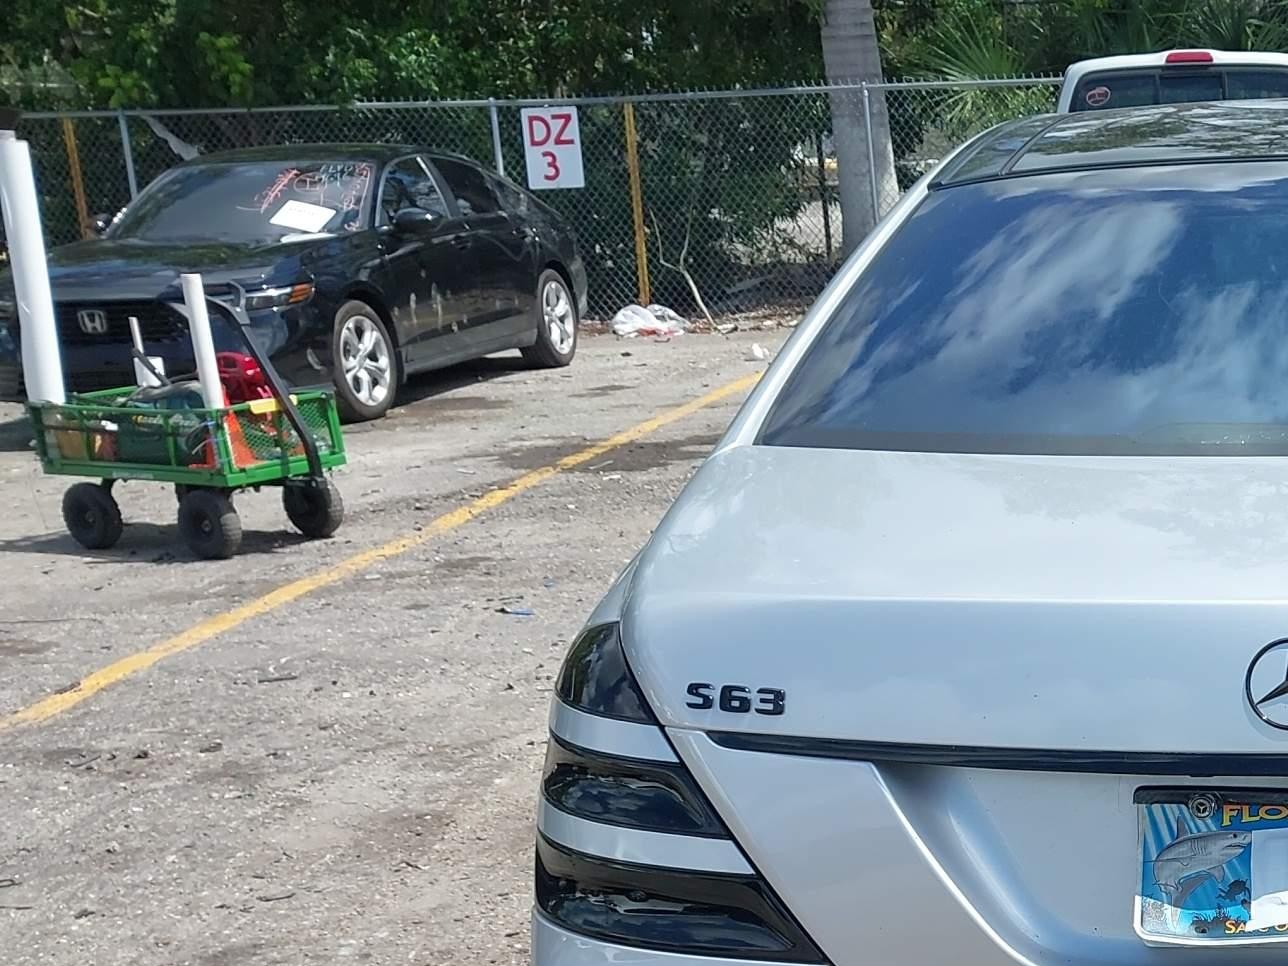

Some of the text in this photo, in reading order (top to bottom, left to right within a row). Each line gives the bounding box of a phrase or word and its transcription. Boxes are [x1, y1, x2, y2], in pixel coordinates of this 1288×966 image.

[528, 113, 575, 147] DZ
[541, 151, 560, 181] 3
[686, 682, 785, 715] S63
[1225, 920, 1269, 934] SA
